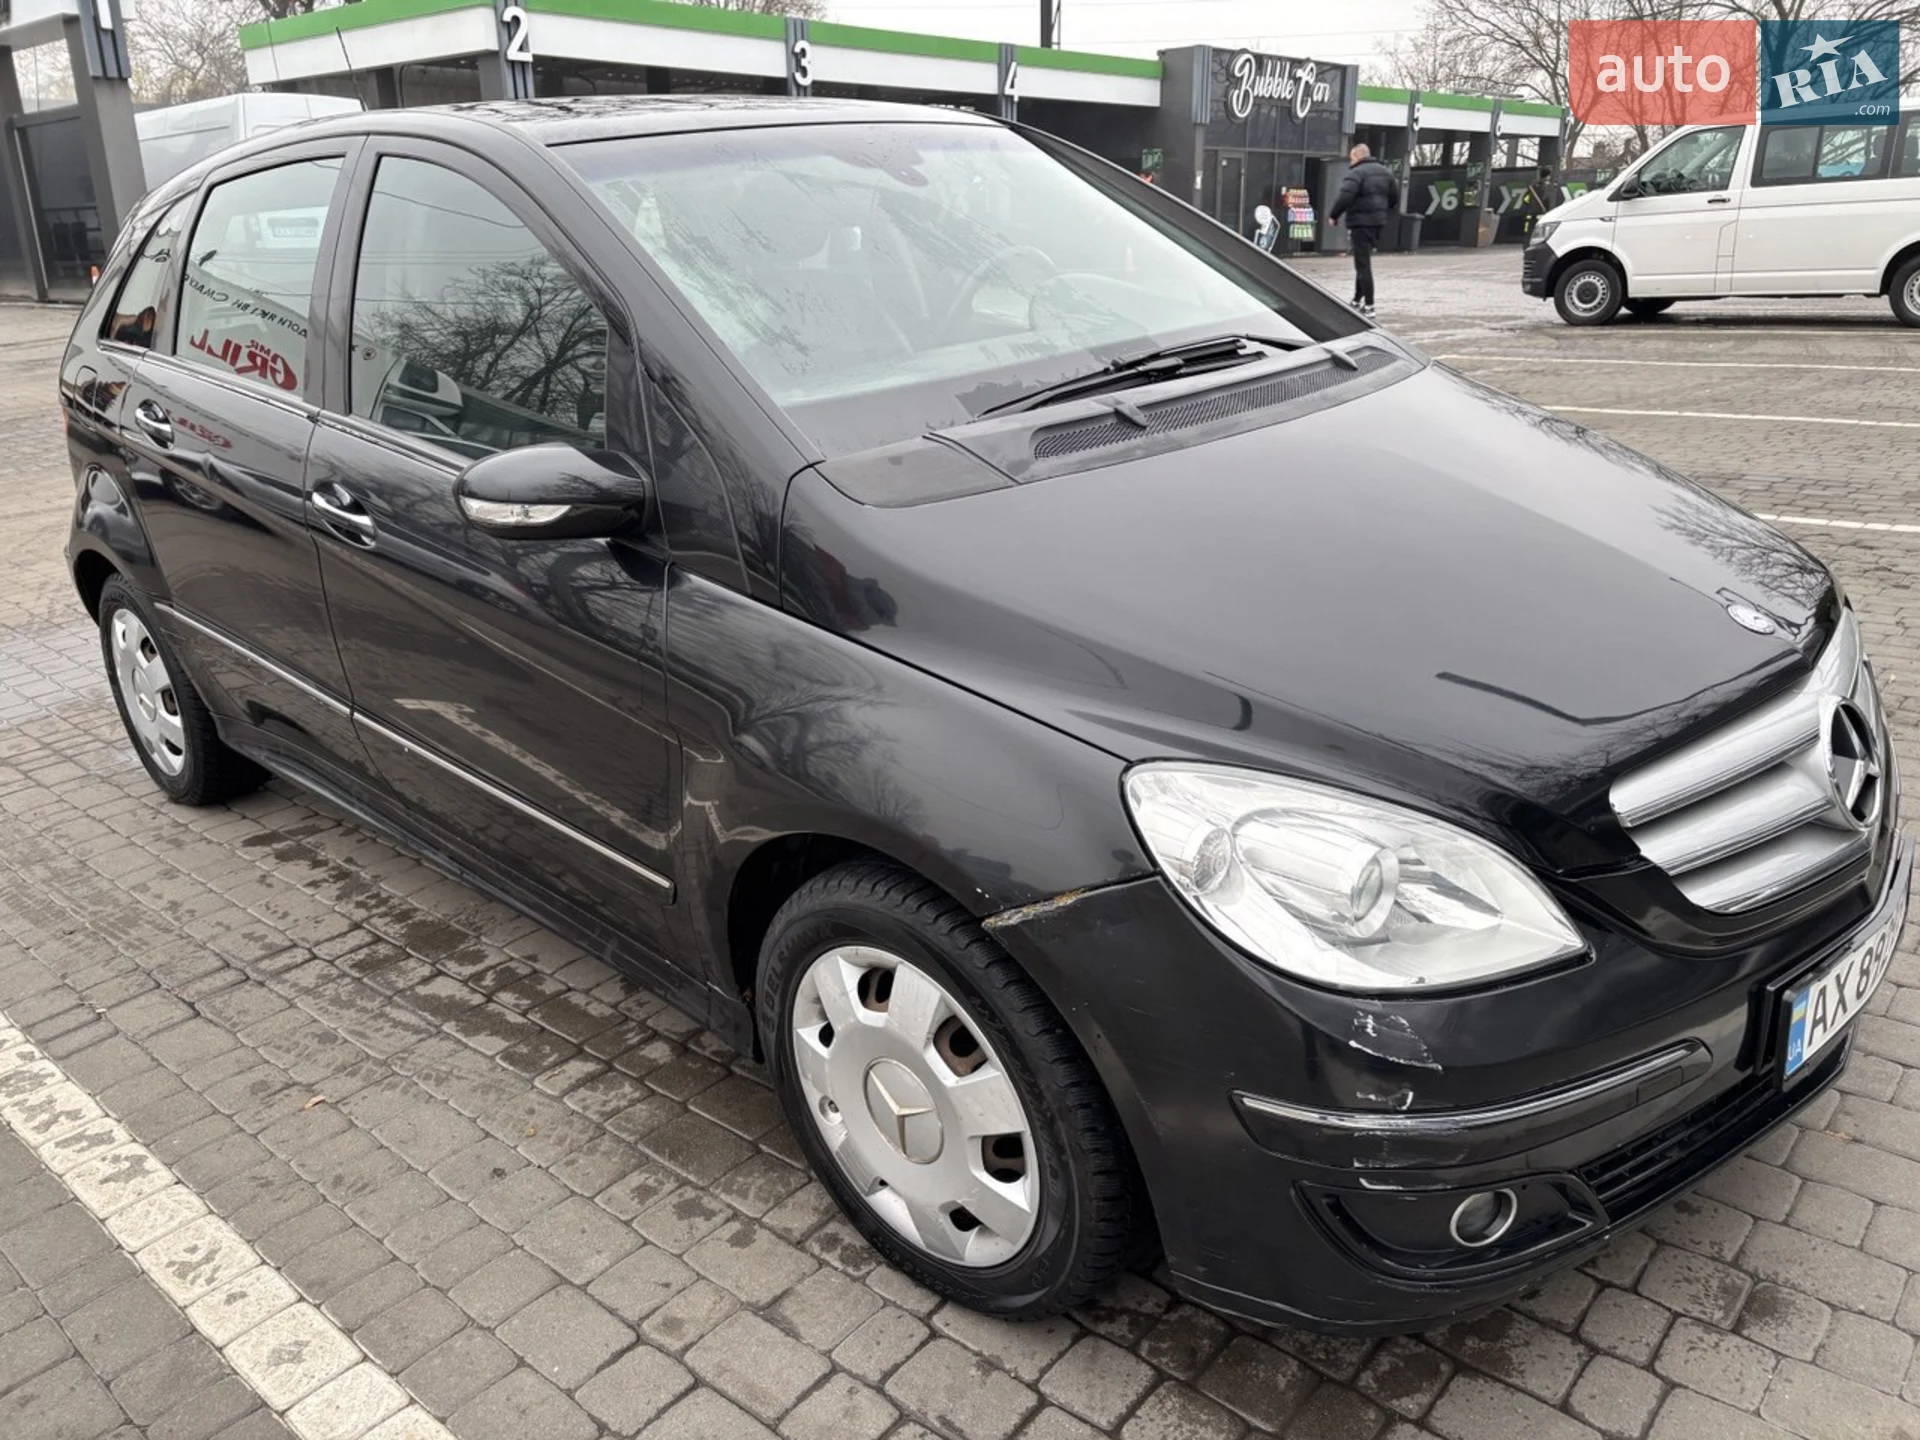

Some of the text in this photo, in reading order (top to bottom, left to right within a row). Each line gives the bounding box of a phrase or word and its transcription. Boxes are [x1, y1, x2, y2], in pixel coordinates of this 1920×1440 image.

[502, 5, 533, 62] 2
[794, 40, 813, 86] 3
[1005, 61, 1020, 102] 4
[1232, 53, 1294, 118] Bubble
[1413, 103, 1423, 131] 5
